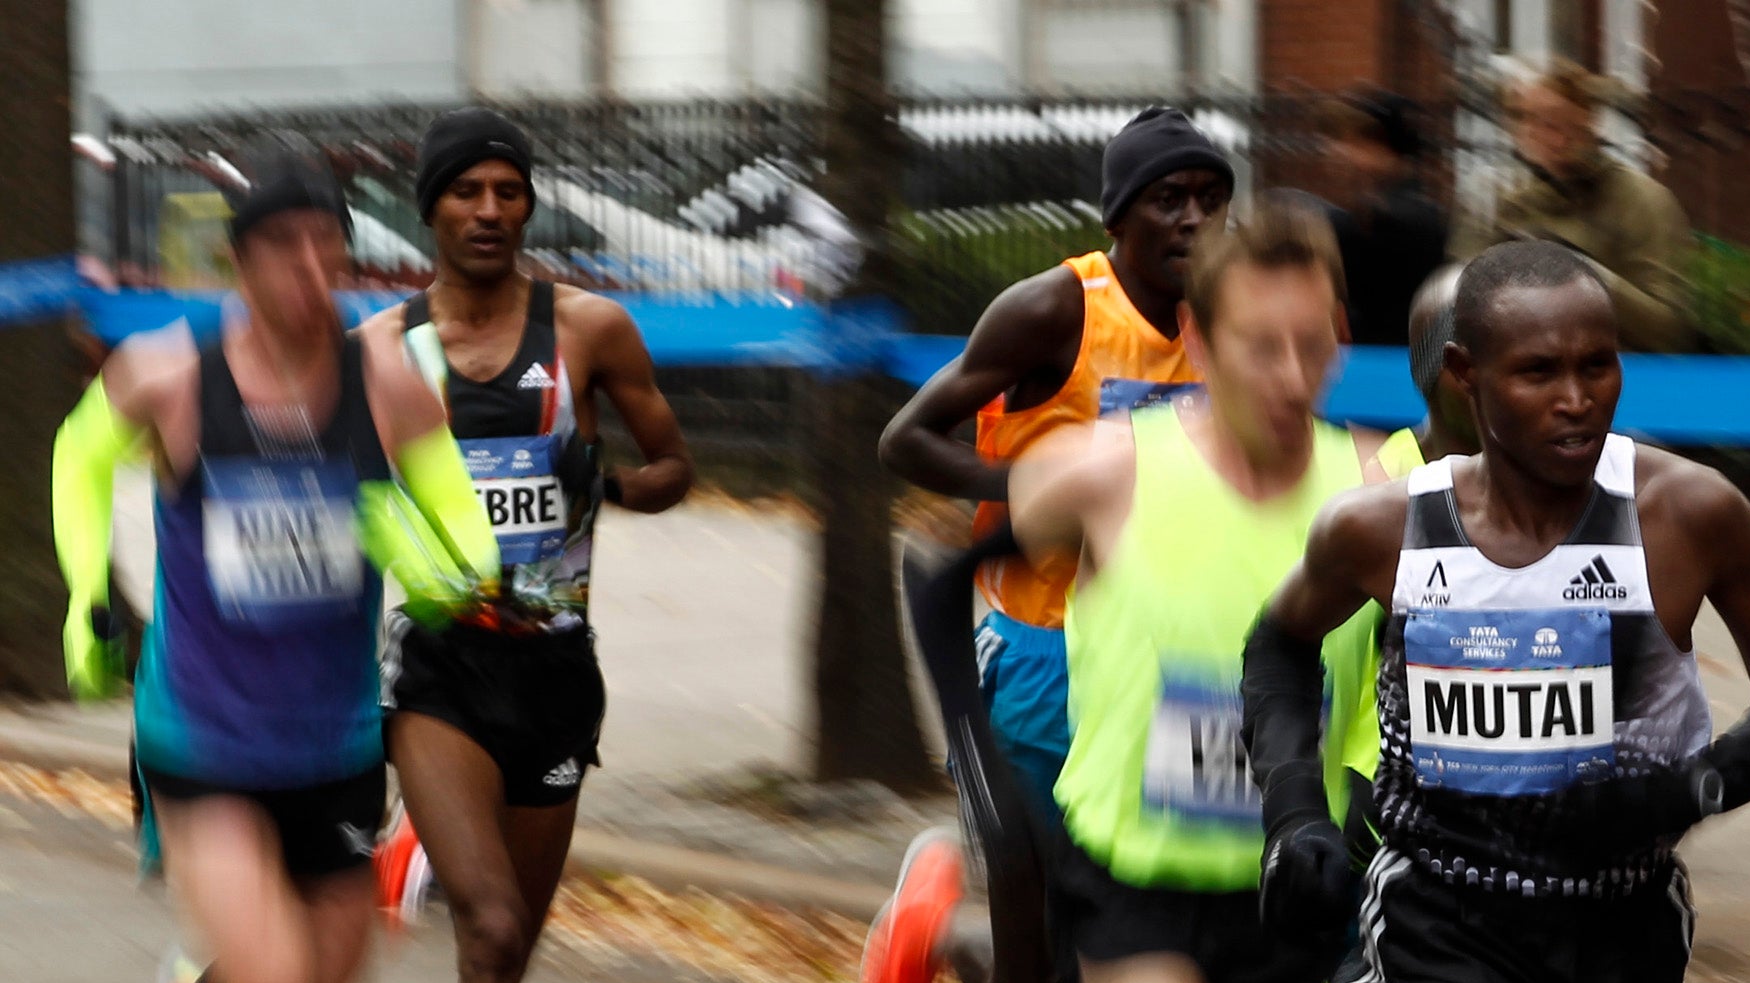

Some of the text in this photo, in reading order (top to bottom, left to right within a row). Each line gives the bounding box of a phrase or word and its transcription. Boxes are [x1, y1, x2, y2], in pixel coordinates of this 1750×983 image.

[475, 484, 558, 526] BRE
[1562, 582, 1628, 600] adidas
[1468, 626, 1499, 636] TATA
[1450, 636, 1518, 648] CONSULTANCY
[1462, 647, 1506, 659] SERVICES
[1531, 645, 1563, 657] TATA
[1423, 679, 1594, 739] MUTAI
